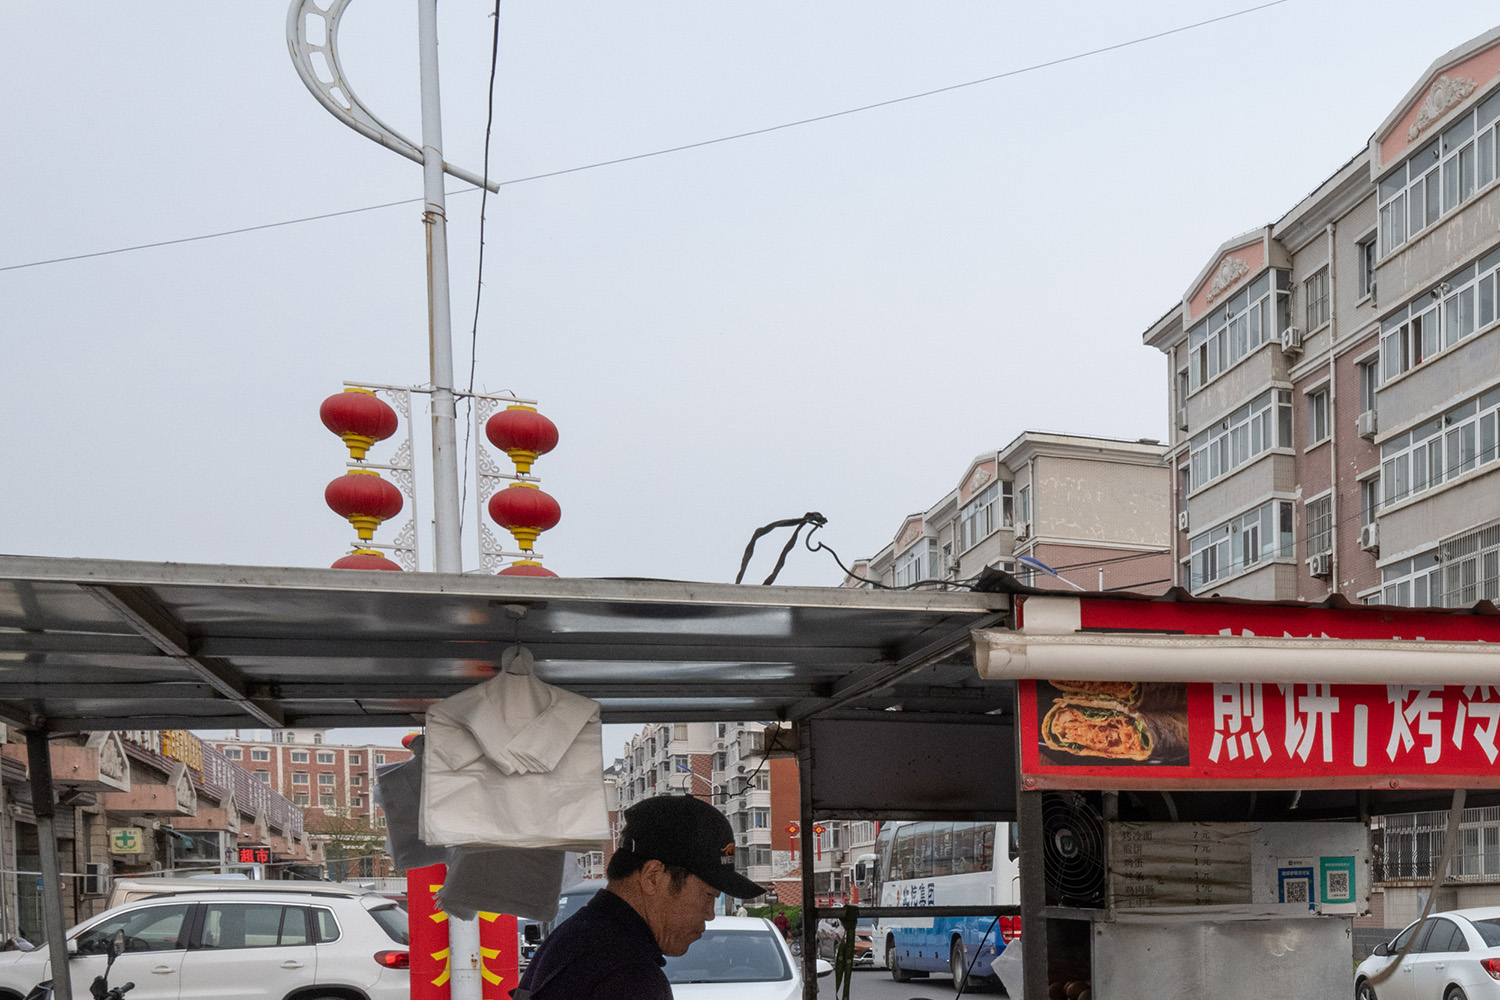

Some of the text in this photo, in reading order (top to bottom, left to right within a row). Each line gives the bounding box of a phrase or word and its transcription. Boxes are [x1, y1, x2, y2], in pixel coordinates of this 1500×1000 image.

[1208, 628, 1340, 764] 煎饼
[1121, 830, 1153, 842] 烤冷面
[240, 848, 269, 864] 超市
